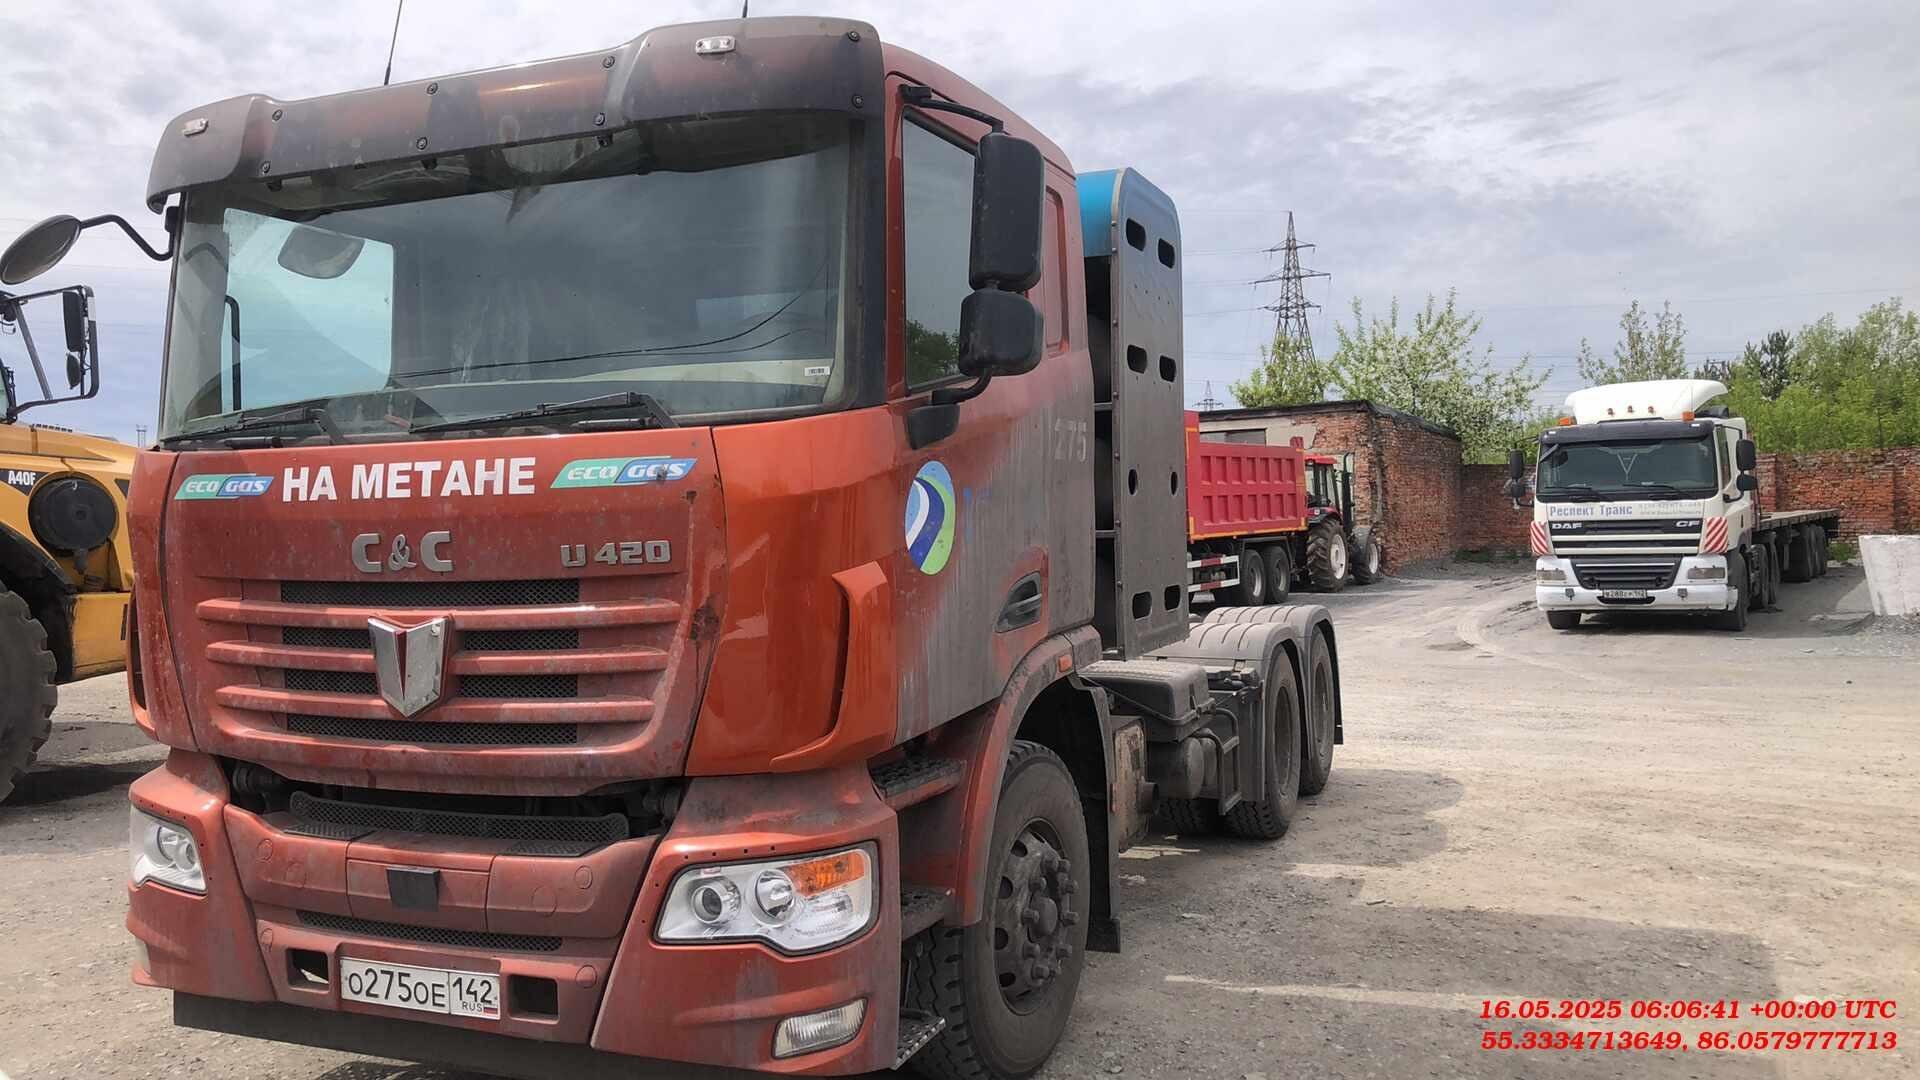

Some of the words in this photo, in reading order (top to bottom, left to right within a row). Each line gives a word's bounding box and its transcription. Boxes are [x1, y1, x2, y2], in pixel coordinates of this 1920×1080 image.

[1054, 418, 1087, 462] 275
[8, 470, 36, 486] A40F
[282, 466, 338, 503] НА
[351, 457, 537, 500] МЕТАНЕ
[1550, 505, 1595, 517] Респект
[1600, 503, 1633, 517] Транс
[1676, 519, 1700, 528] CF
[351, 530, 454, 573] C&C
[593, 540, 671, 565] 420
[452, 976, 493, 1004] 142
[462, 1000, 482, 1013] RUS
